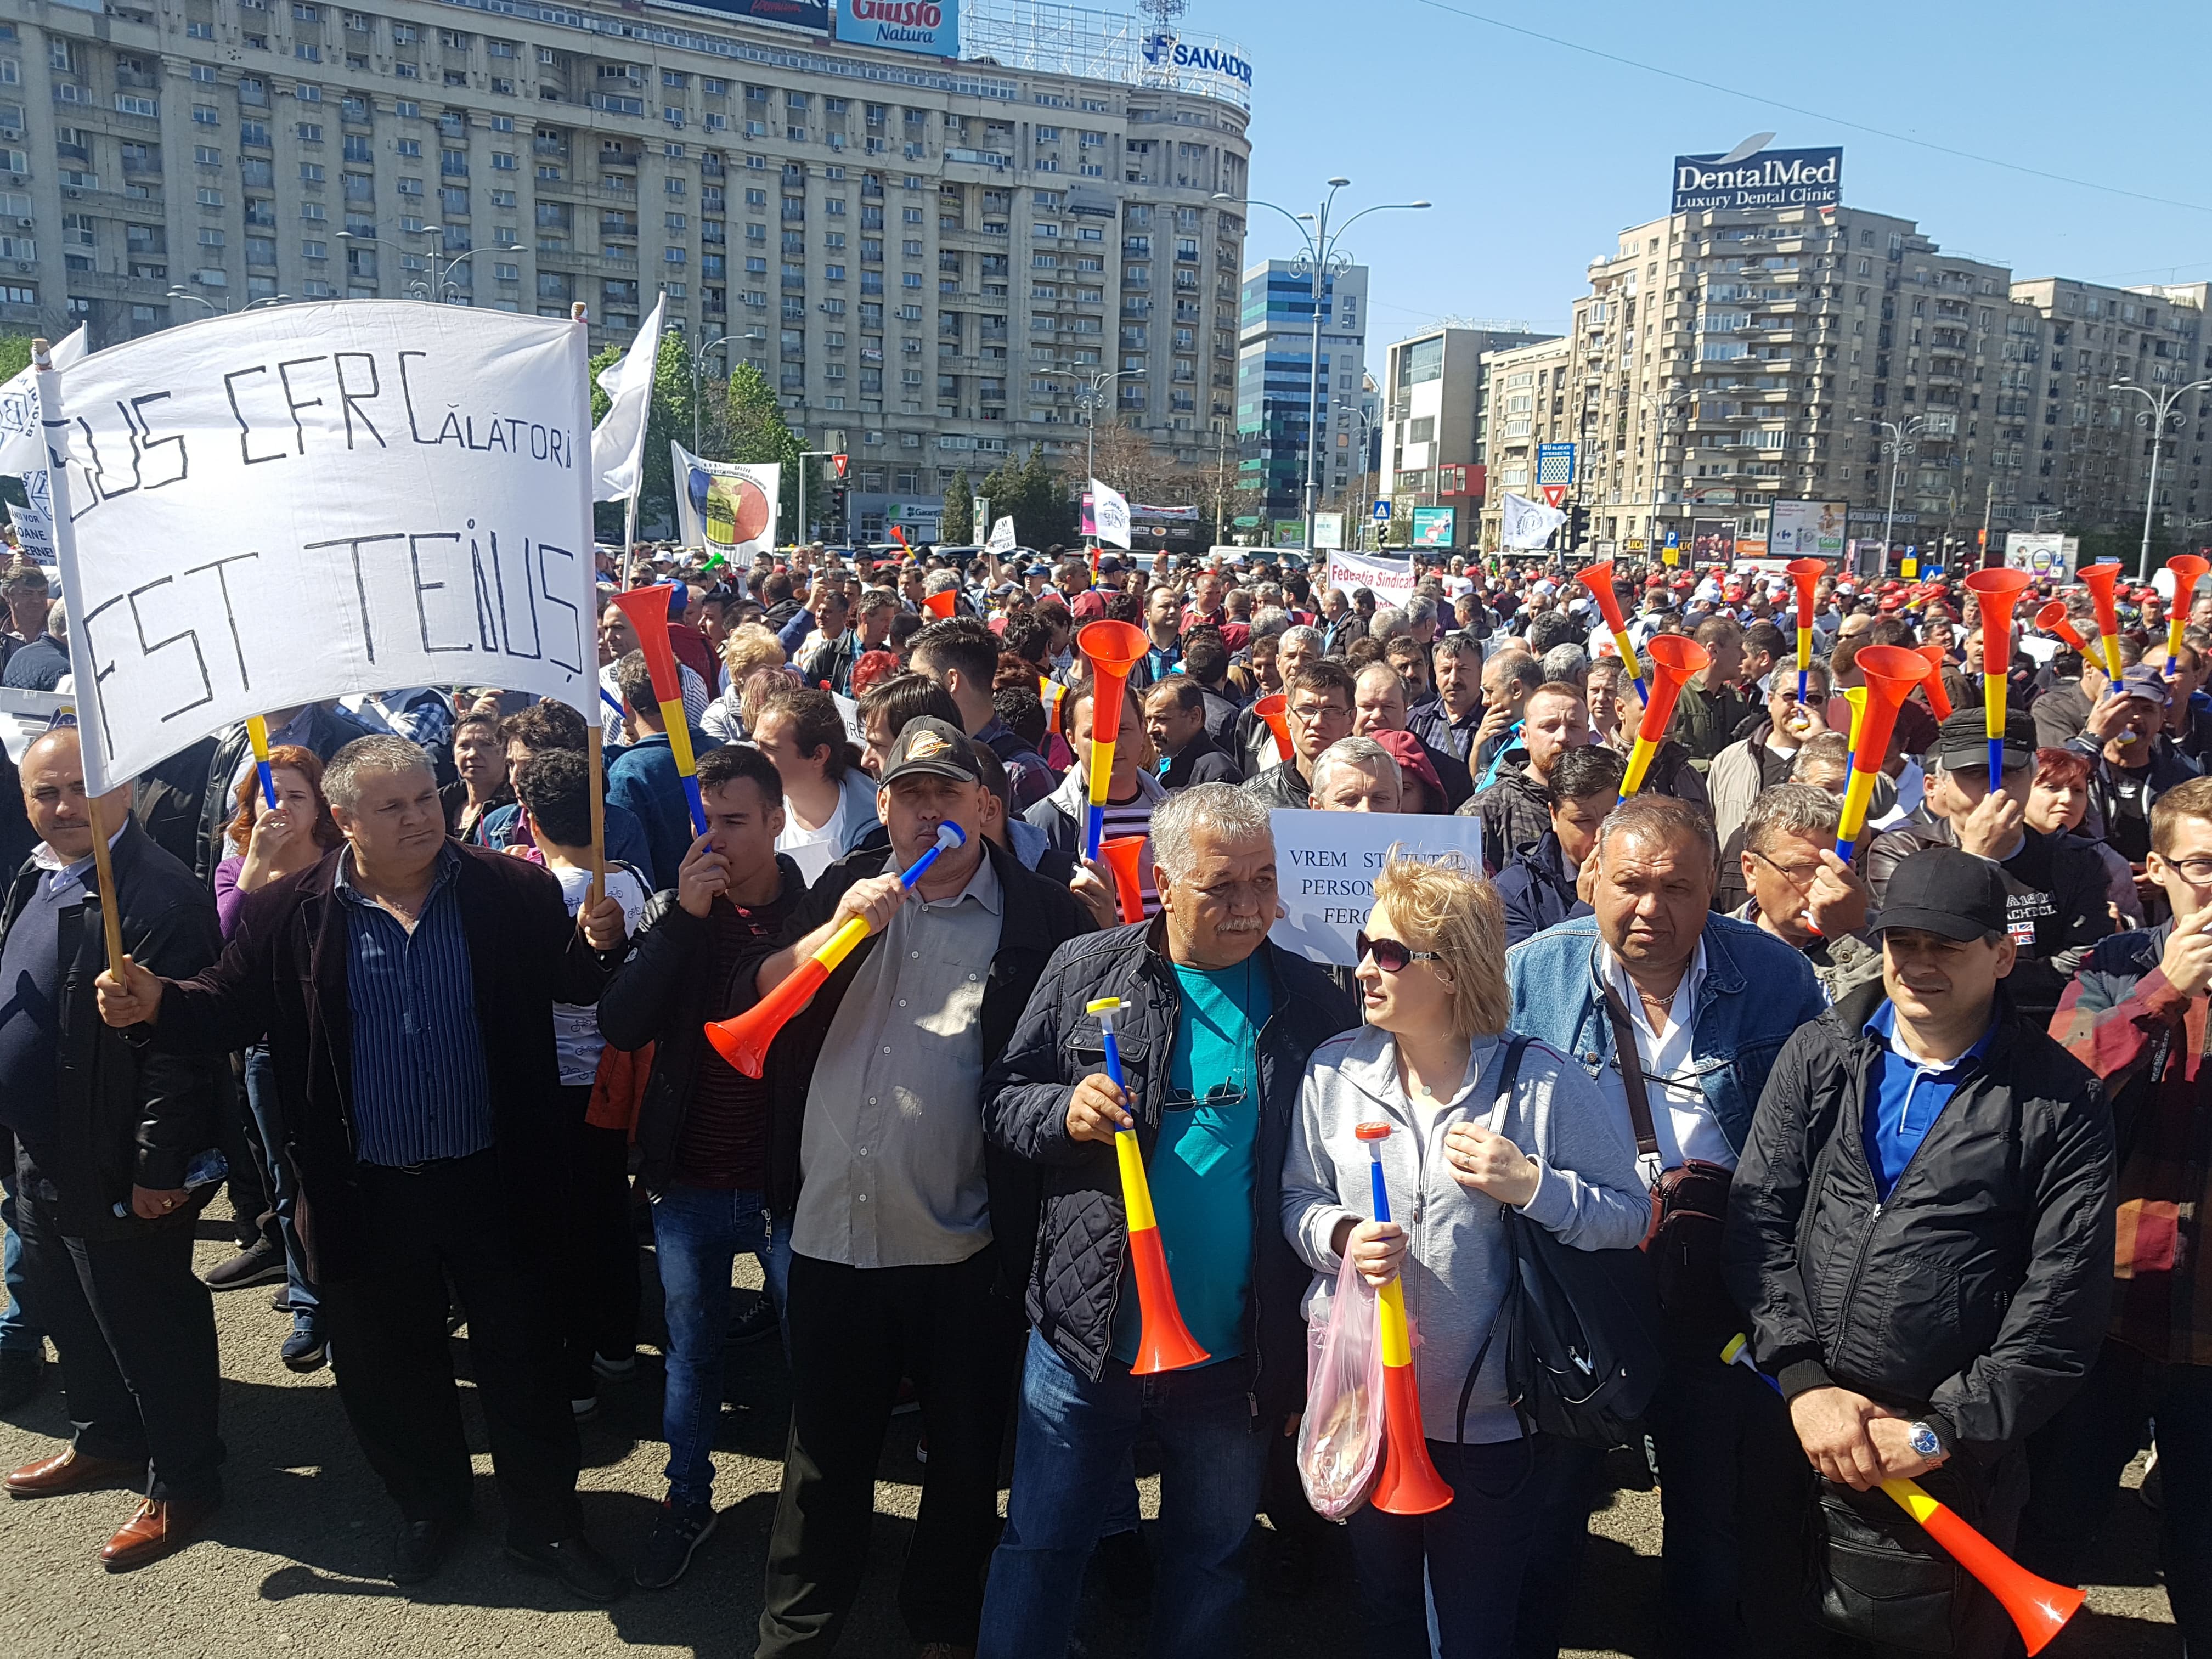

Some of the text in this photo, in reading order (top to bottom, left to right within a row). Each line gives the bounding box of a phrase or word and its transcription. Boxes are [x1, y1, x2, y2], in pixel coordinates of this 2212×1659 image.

[852, 0, 941, 27] Giusto
[876, 22, 935, 44] Natura
[1173, 43, 1253, 87] SANADOR
[1676, 156, 1837, 191] DentalMed
[1675, 187, 1836, 208] Luxury Dental Clinic
[224, 352, 386, 465] CFR
[23, 514, 40, 523] VOR
[16, 525, 47, 541] OANE
[1668, 532, 1675, 545] P
[20, 544, 55, 558] ERNE!
[1628, 540, 1643, 549] LUCA
[1907, 546, 1914, 557] P
[2055, 555, 2061, 565] P
[1289, 850, 1347, 867] VREM
